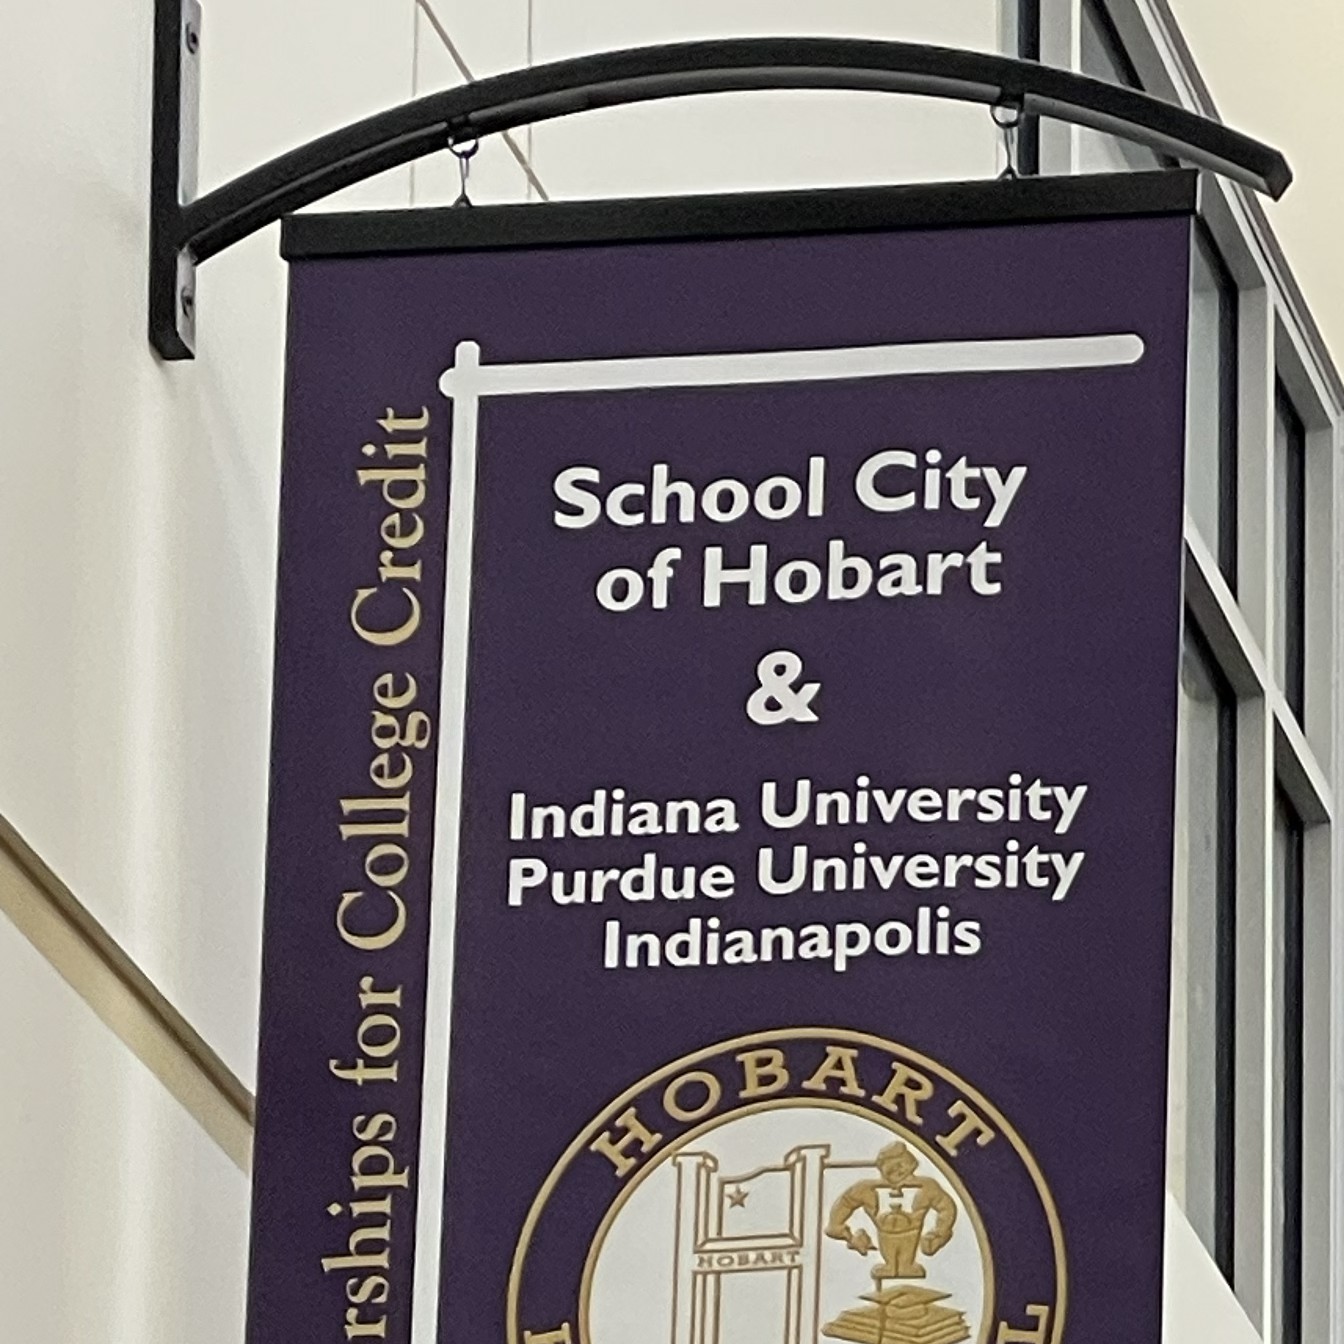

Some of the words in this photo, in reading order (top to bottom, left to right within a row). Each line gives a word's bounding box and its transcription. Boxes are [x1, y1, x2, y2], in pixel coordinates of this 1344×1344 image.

[350, 405, 430, 646] Credit
[553, 456, 825, 530] School
[855, 448, 1028, 528] City
[595, 547, 682, 612] of
[703, 539, 1003, 608] Hobart
[746, 650, 822, 726] &
[336, 672, 431, 951] College
[510, 788, 741, 841] Indiana
[761, 773, 1088, 835] University
[507, 852, 735, 907] Purdue
[758, 839, 1086, 902] University
[604, 905, 982, 973] Indianapolis
[329, 976, 402, 1086] for
[590, 1046, 996, 1177] HOBART
[696, 1249, 801, 1269] HOBART
